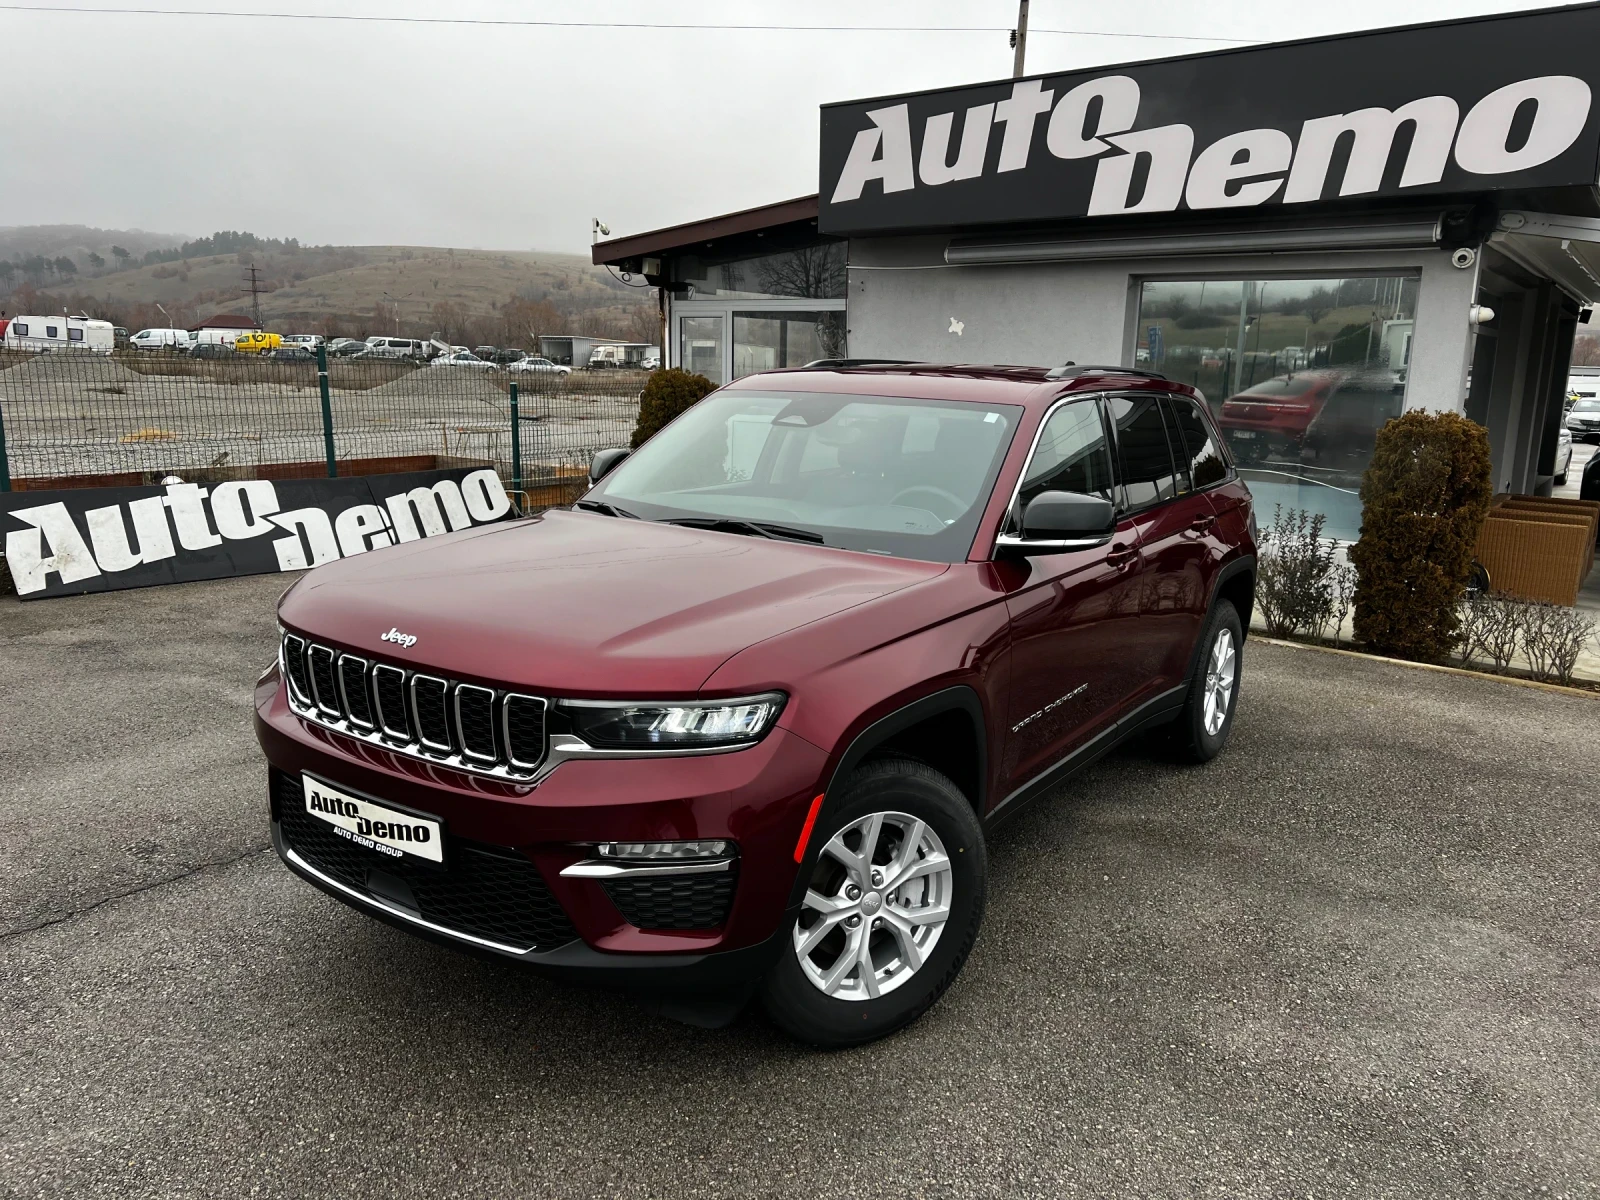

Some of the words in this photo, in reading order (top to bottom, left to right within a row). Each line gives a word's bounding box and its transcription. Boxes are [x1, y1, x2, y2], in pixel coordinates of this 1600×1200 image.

[830, 75, 1141, 204] Auto
[1086, 75, 1592, 216] Demo
[5, 479, 281, 596] Auto
[261, 469, 511, 572] Demo
[380, 627, 418, 649] Jeep
[310, 790, 359, 818] Auto
[356, 815, 431, 843] Demo
[333, 826, 352, 840] AUTO
[352, 835, 375, 849] DEMO
[375, 843, 403, 858] GROUP
